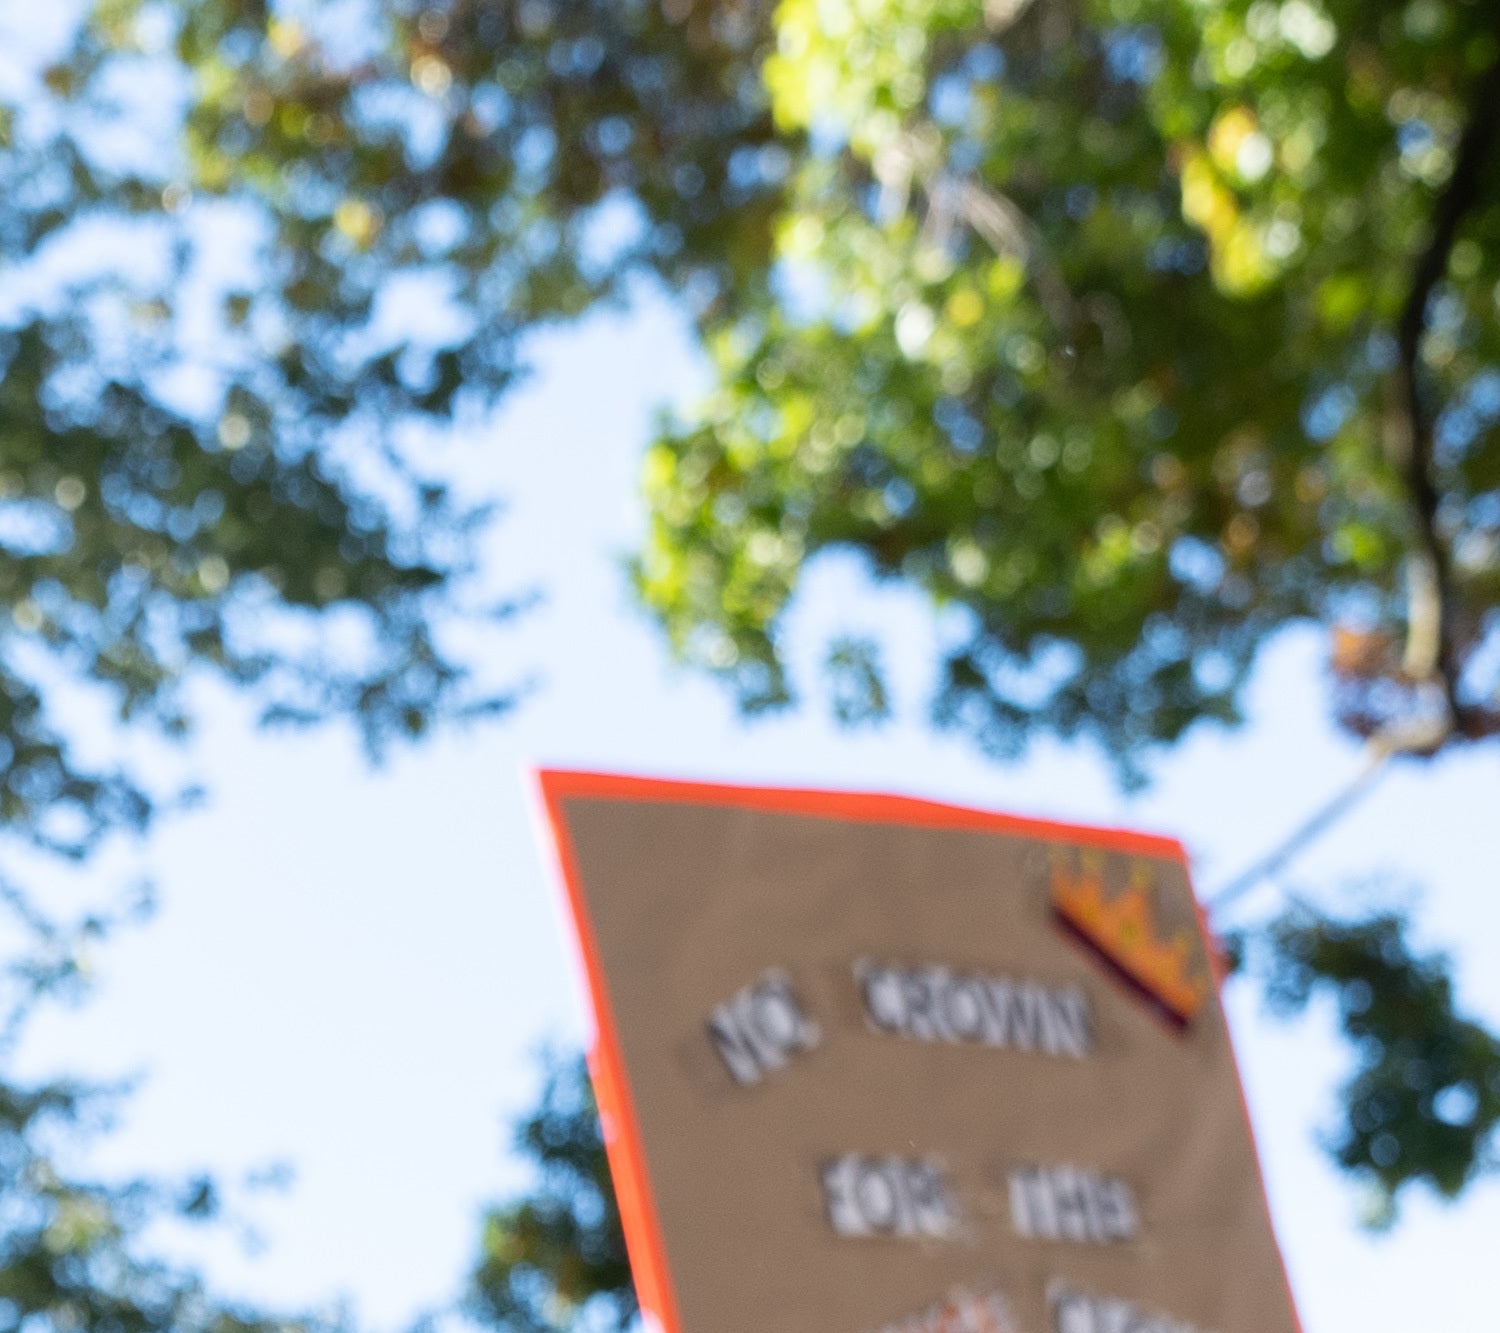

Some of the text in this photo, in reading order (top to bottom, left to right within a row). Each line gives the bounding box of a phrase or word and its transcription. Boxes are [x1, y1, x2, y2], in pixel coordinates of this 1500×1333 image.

[710, 978, 814, 1084] NO
[822, 1153, 1142, 1245] FOR THE
